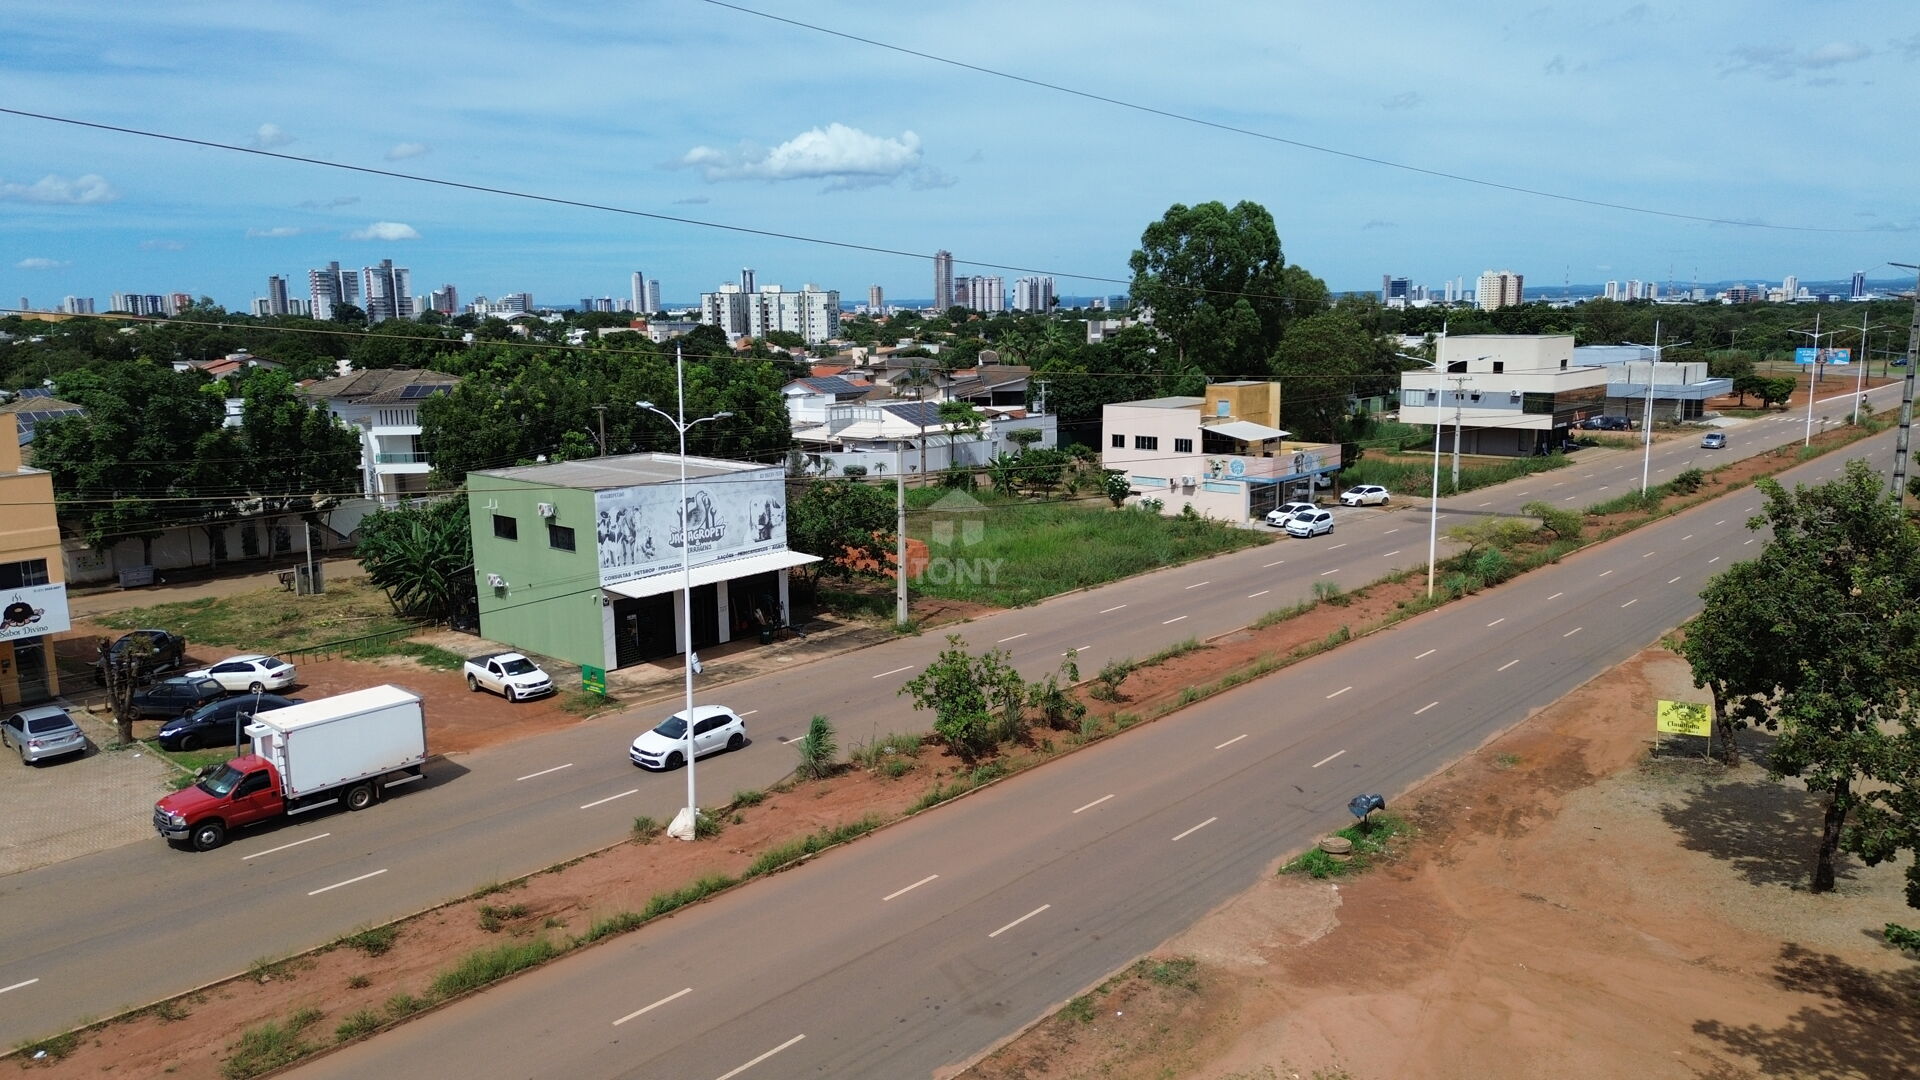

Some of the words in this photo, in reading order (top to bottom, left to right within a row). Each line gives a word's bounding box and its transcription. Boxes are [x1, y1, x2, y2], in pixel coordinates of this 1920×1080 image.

[687, 525, 725, 542] AGROPET
[604, 572, 631, 581] CONSULTAS
[0, 629, 21, 639] Sabor
[23, 626, 48, 635] Divino
